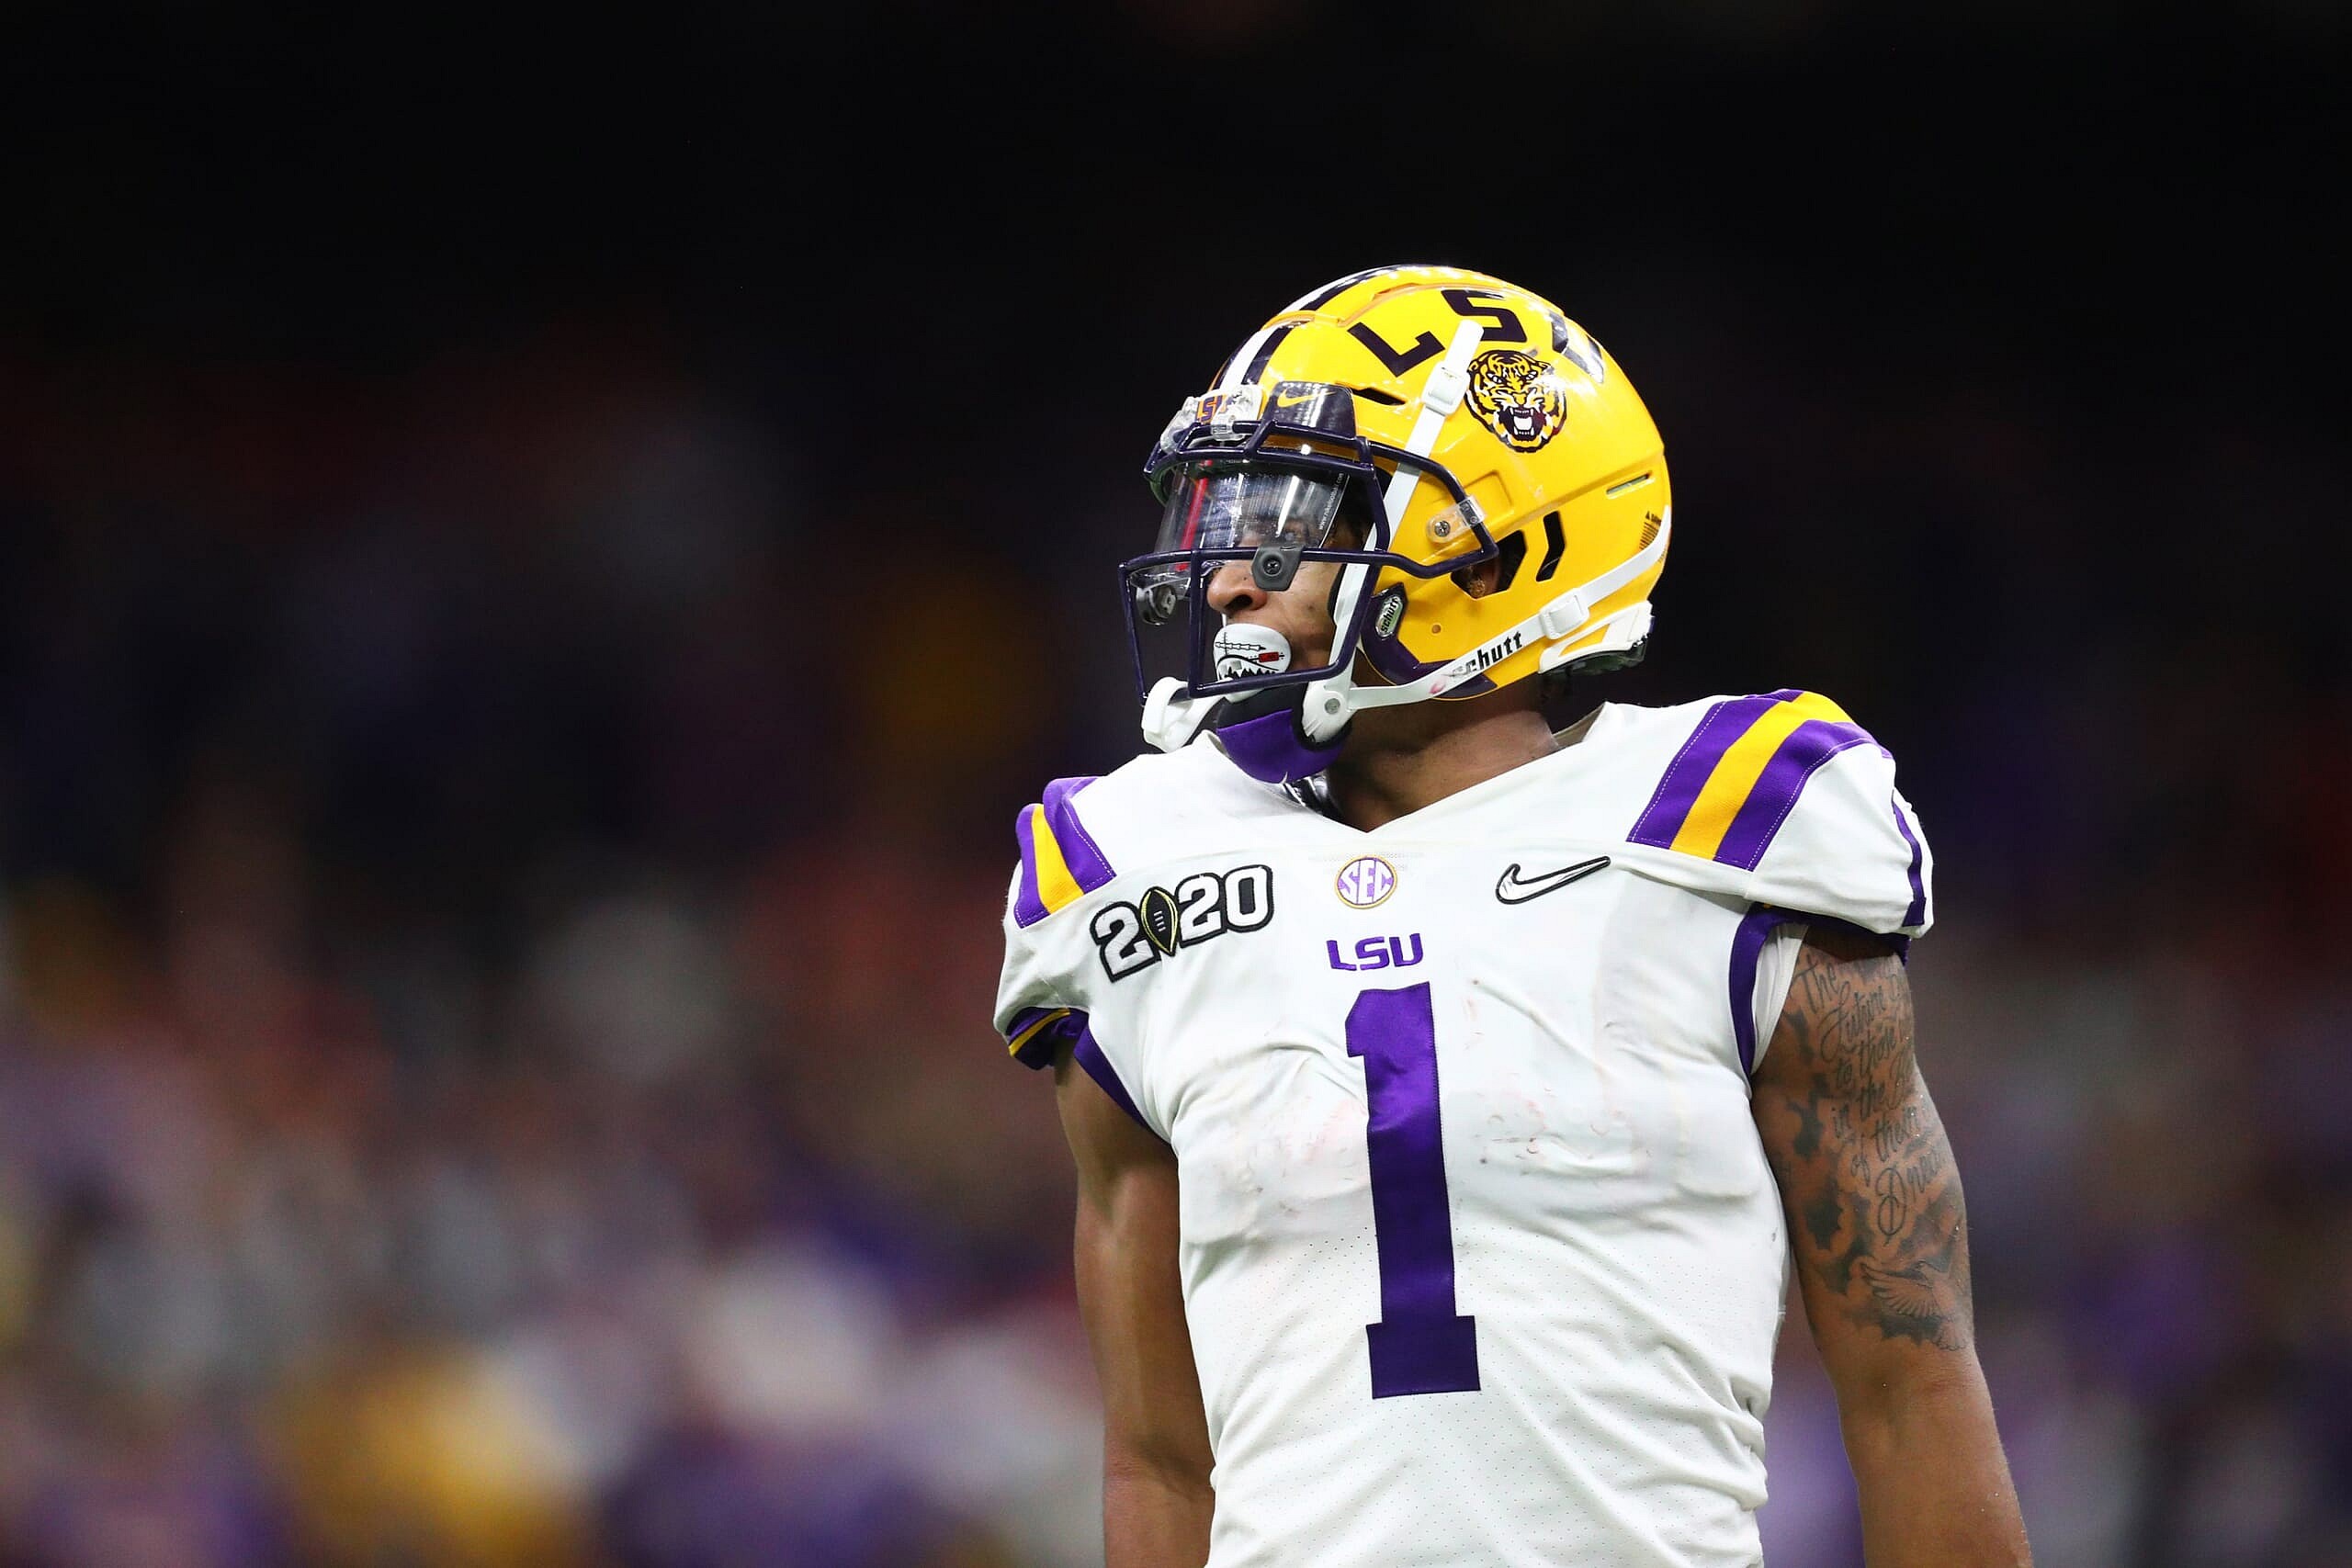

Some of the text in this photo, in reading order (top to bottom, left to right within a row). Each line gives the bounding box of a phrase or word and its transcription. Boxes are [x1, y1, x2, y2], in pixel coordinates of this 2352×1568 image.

[1380, 597, 1398, 633] schutt
[1337, 856, 1395, 906] SEC
[1326, 933, 1423, 971] LSU
[1345, 981, 1480, 1399] 1
